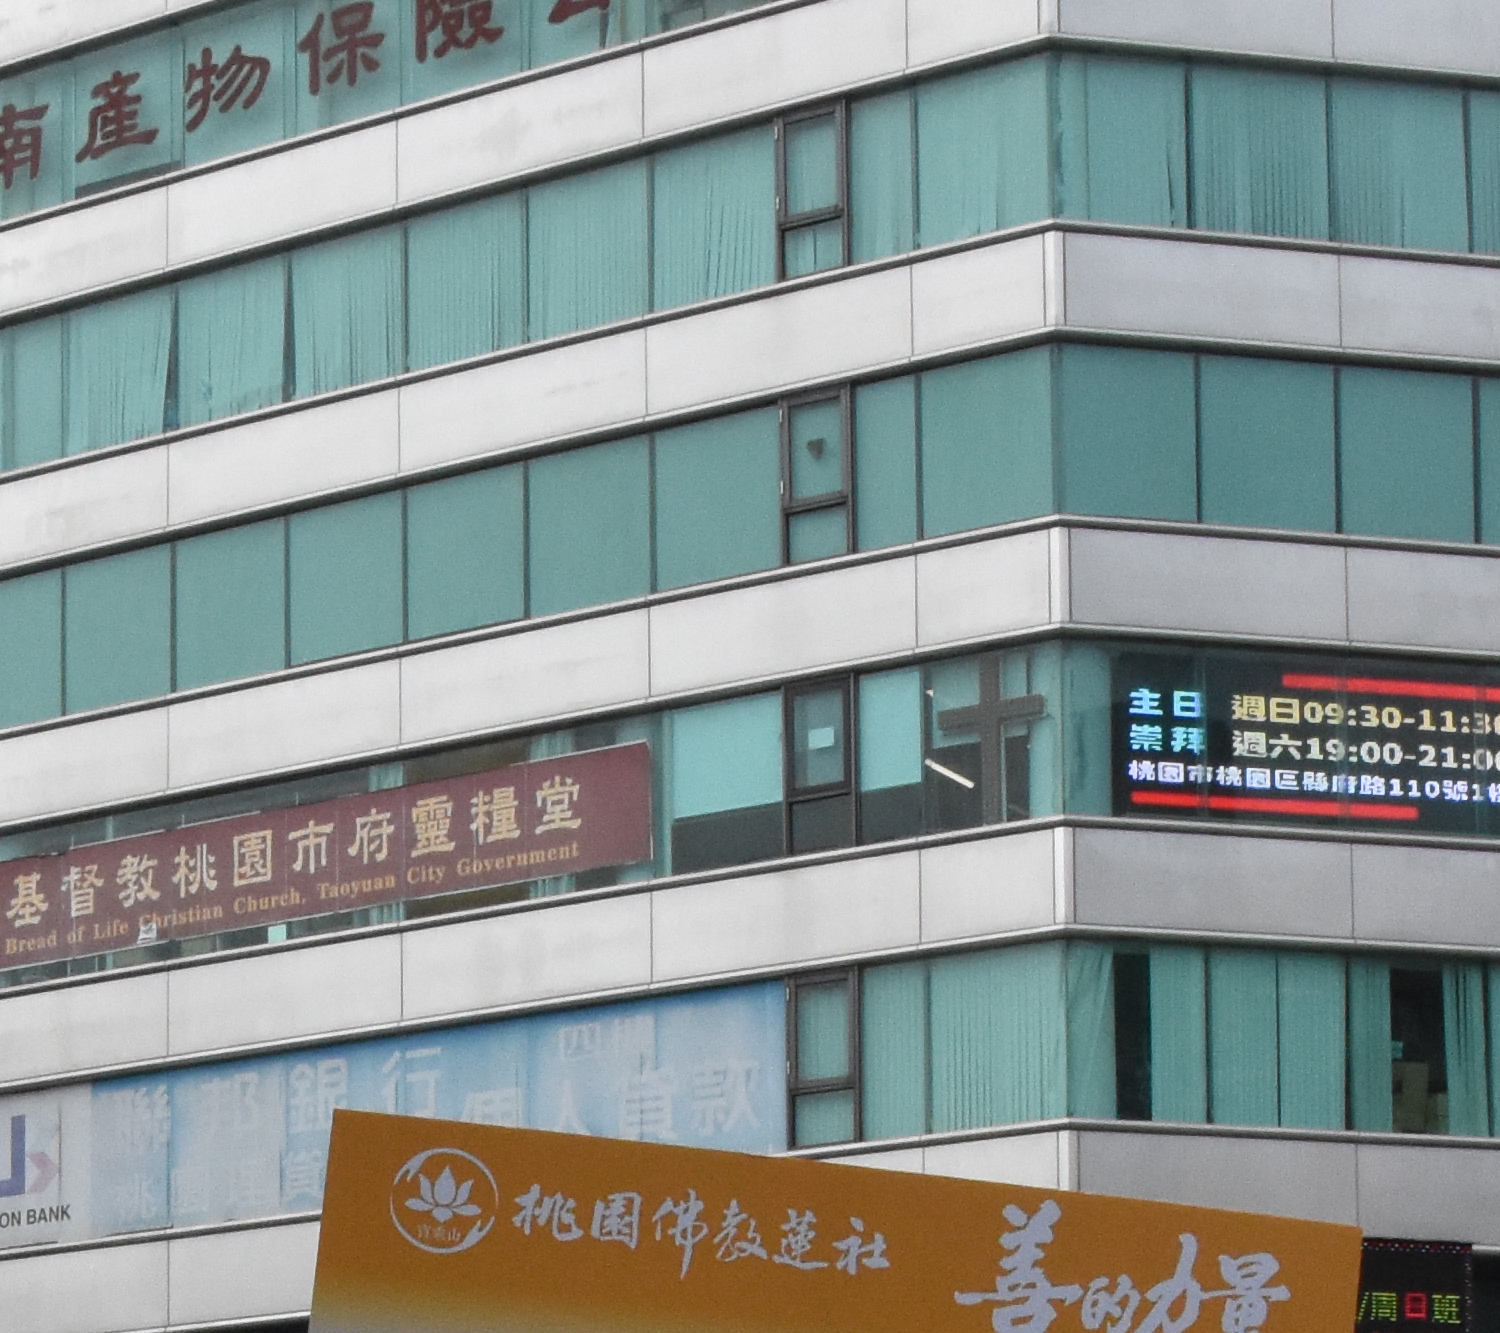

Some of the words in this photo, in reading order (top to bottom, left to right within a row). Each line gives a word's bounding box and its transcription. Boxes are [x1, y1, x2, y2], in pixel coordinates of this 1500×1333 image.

[1129, 688, 1201, 718] 主日
[1130, 724, 1205, 754] 崇拜
[6, 775, 582, 928] 基督教桃園市府靈糧堂
[5, 935, 57, 954] Bread
[66, 927, 85, 945] of
[95, 919, 129, 940] Life
[139, 904, 224, 929] Christian
[233, 889, 306, 915] Church,
[317, 873, 396, 902] Taoyuan
[407, 863, 446, 886] City
[457, 841, 580, 876] Government
[27, 1203, 71, 1226] BANK
[512, 1182, 890, 1280] 桃園佛教蓮社
